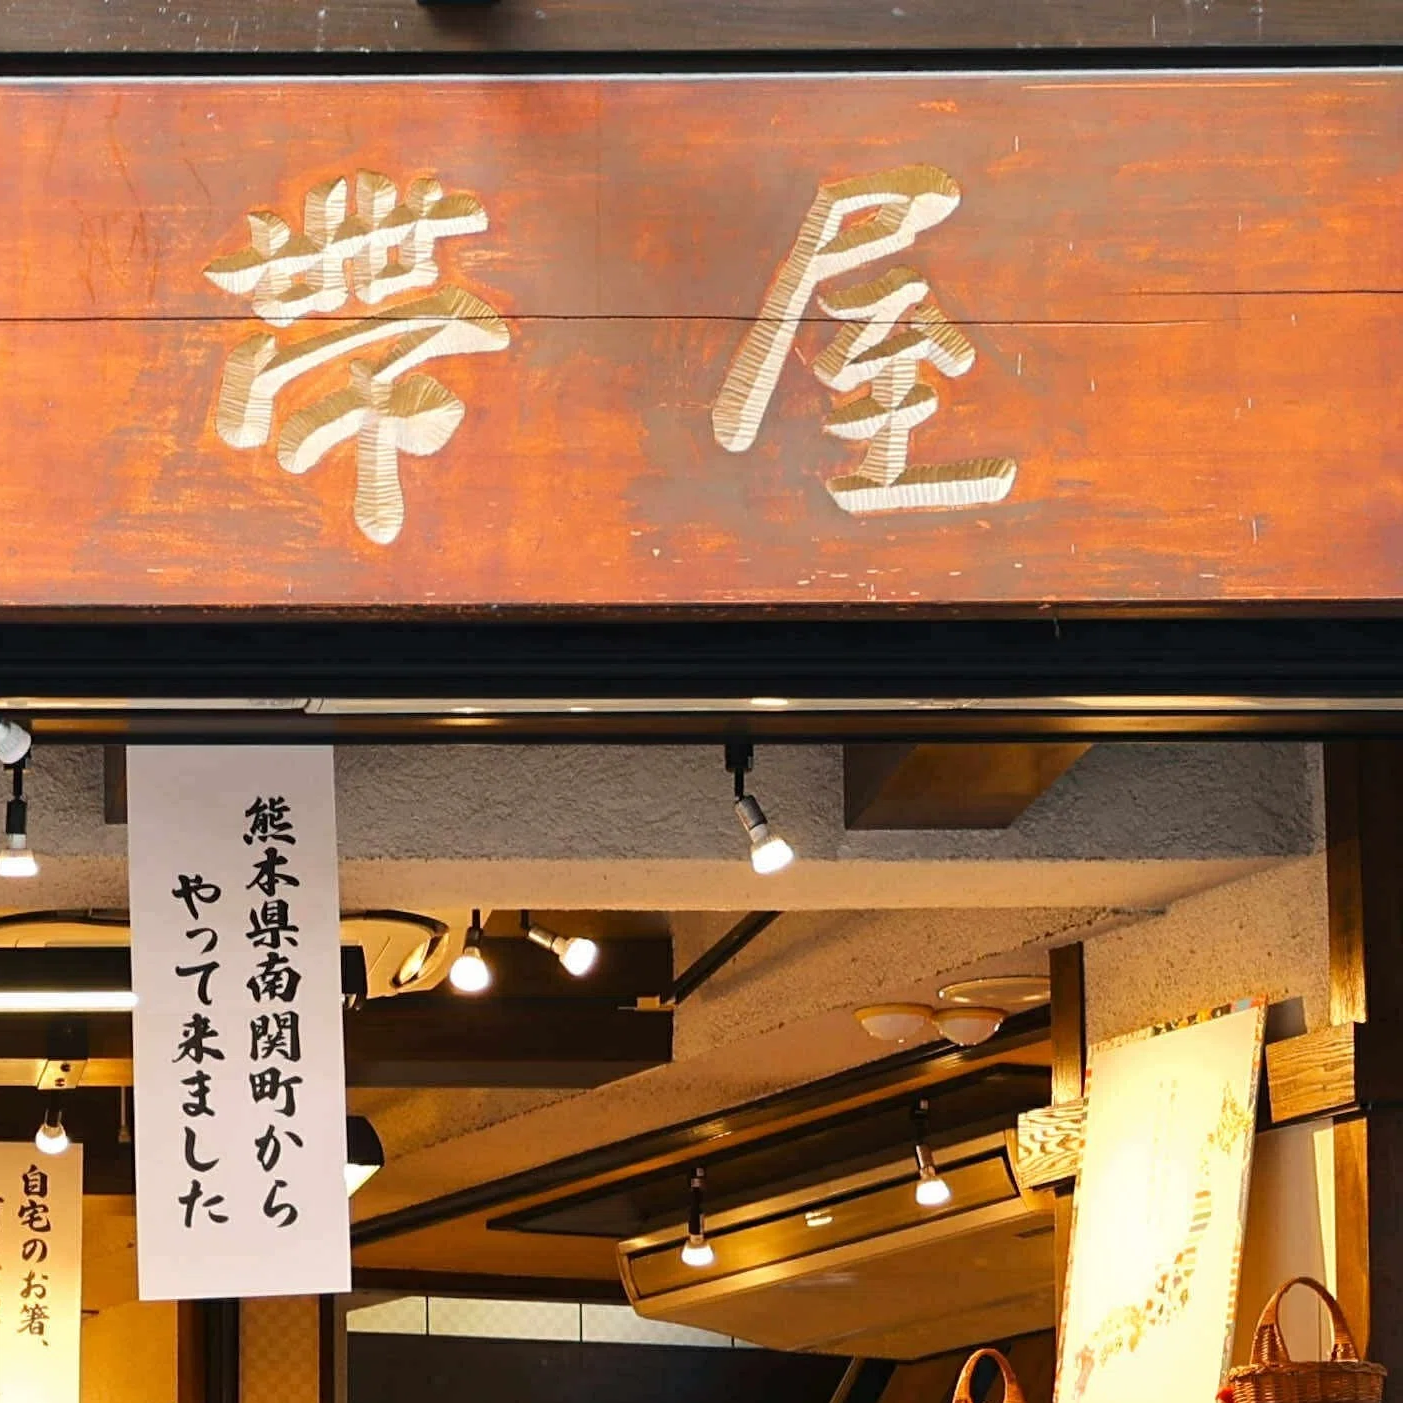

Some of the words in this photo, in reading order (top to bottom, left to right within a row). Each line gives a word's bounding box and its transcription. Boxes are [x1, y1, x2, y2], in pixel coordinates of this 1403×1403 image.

[171, 873, 229, 1229] やって来ました
[242, 796, 303, 1229] 熊本県南関町から
[16, 1164, 51, 1347] 自宅のお箸、
